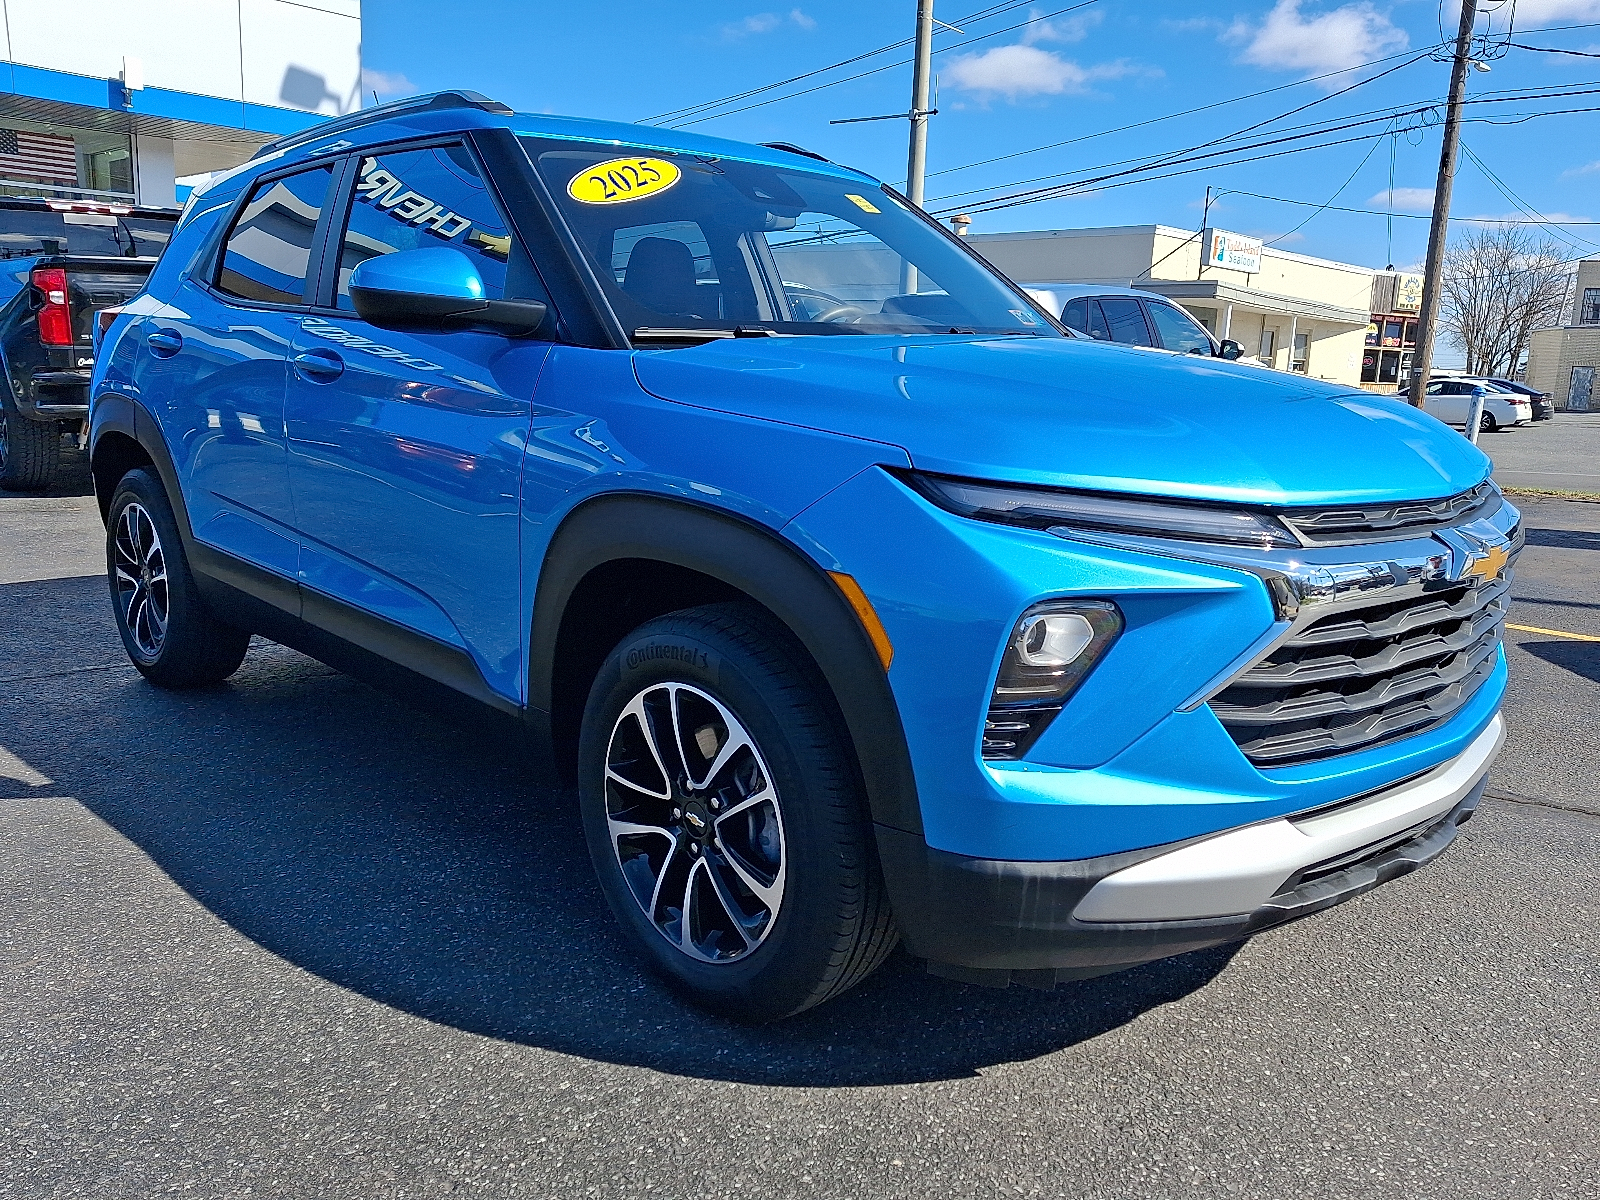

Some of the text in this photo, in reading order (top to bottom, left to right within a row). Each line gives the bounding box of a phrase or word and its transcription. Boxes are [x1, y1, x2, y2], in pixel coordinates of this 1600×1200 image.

[589, 160, 661, 199] 2025
[1228, 251, 1255, 268] Seafood
[626, 641, 699, 670] Continental
